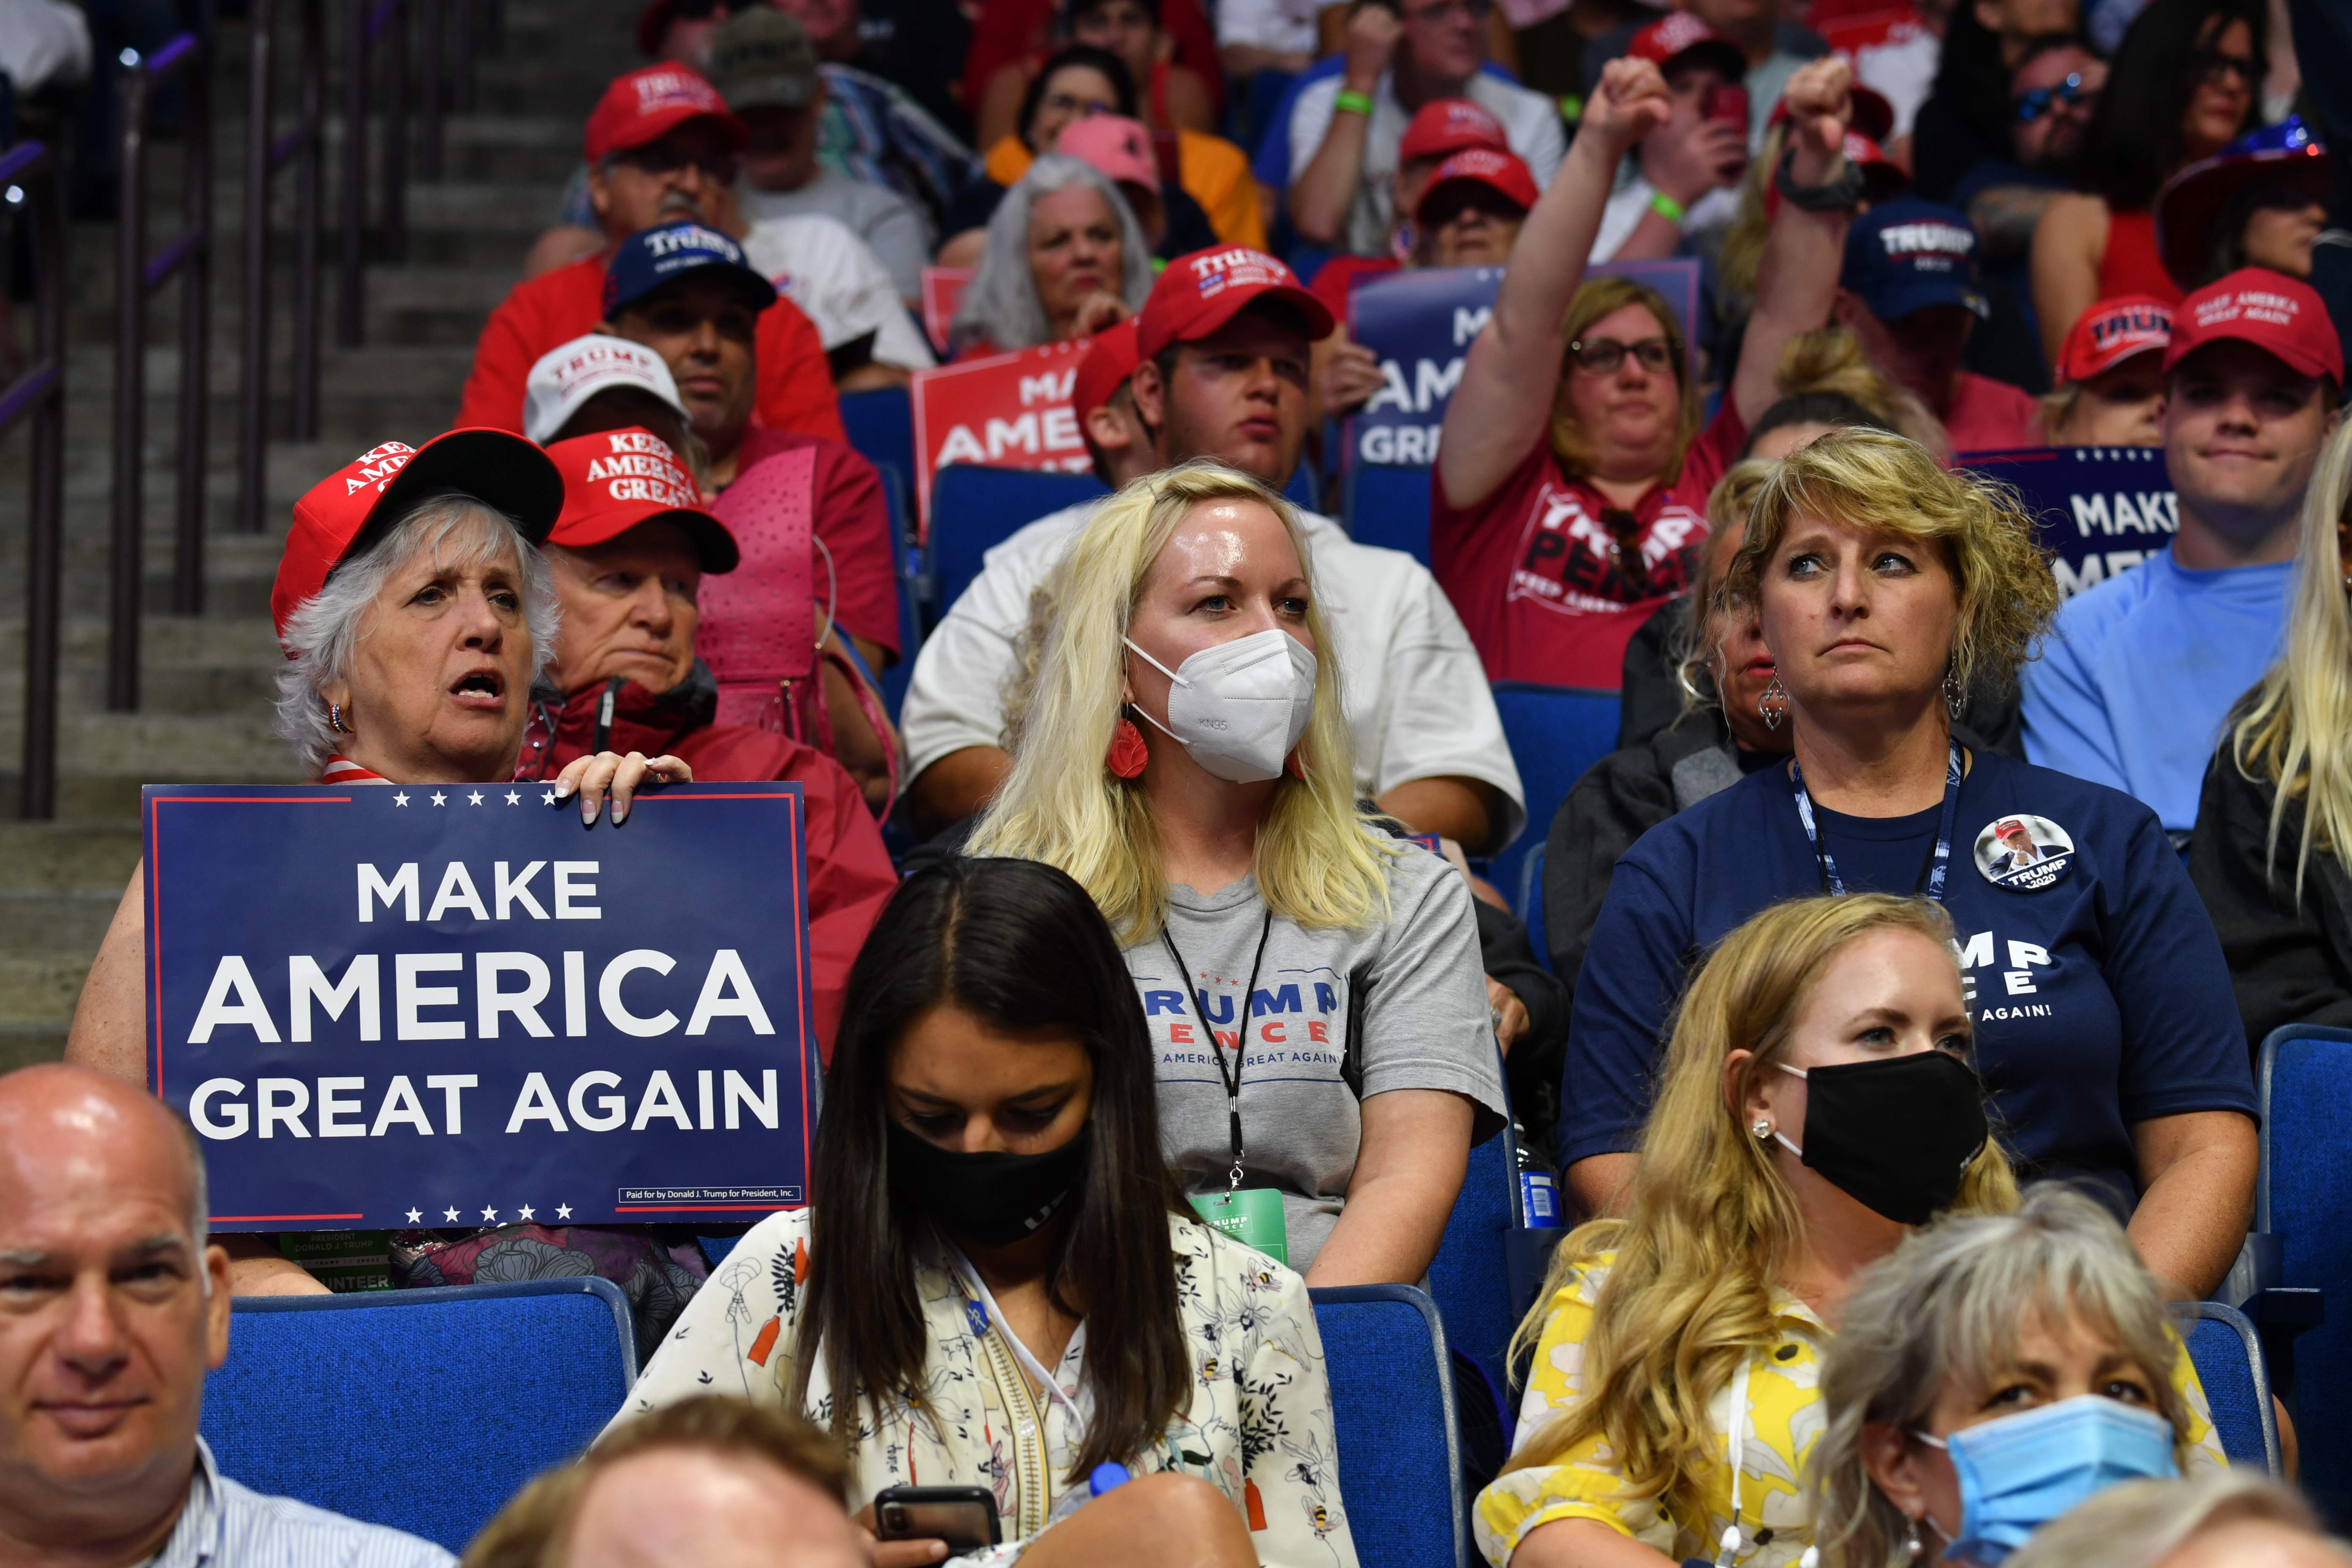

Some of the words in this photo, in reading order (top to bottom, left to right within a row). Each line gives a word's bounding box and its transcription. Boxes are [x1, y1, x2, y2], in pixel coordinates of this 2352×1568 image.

[550, 347, 651, 380] TRUMP
[608, 433, 674, 463] KEEP
[586, 454, 699, 505] AMERICA
[608, 478, 690, 508] GREAT
[1199, 719, 1227, 731] KN95
[2008, 859, 2066, 886] TRUMP
[2030, 873, 2056, 888] 2020
[357, 861, 602, 922] MAKE
[187, 949, 776, 1044] AMERICA
[1144, 982, 1337, 1025] RUMP
[1982, 1004, 2052, 1021] AGAIN!
[1170, 1021, 1330, 1050] ENCE
[1292, 1052, 1341, 1064] AGAIN!
[189, 1074, 478, 1141] GREAT
[505, 1069, 779, 1133] AGAIN
[626, 1190, 642, 1199] Paid
[644, 1190, 655, 1198] for
[657, 1190, 666, 1200] by
[668, 1190, 694, 1198] Donald
[696, 1190, 702, 1198] J.
[702, 1190, 727, 1199] Trump
[729, 1189, 740, 1198] for
[741, 1189, 779, 1198] President,
[780, 1189, 794, 1197] Inc.
[295, 1242, 332, 1252] DONALD
[343, 1240, 373, 1249] TRUMP
[311, 1233, 356, 1242] PRESIDENT
